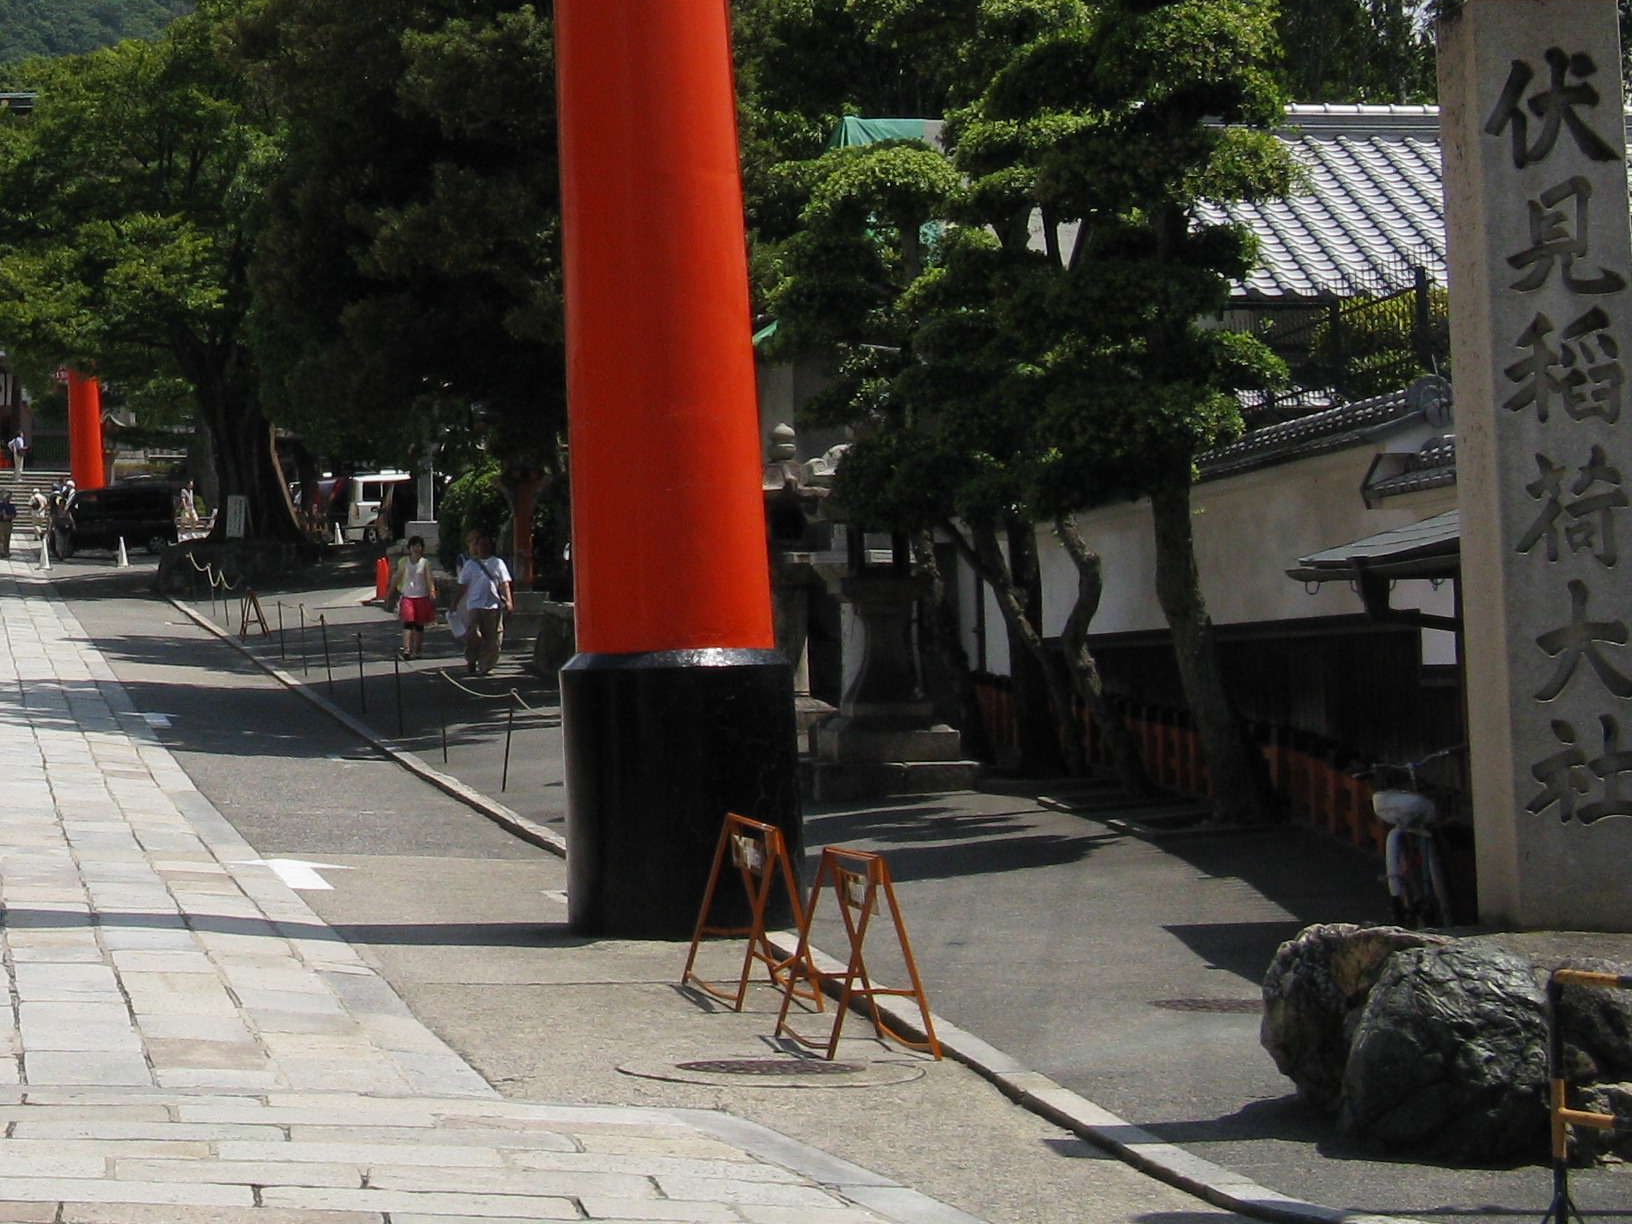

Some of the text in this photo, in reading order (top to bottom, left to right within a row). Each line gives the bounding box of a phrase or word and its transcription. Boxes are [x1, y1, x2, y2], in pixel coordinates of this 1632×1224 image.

[1483, 46, 1632, 827] 伏見稲荷大社
